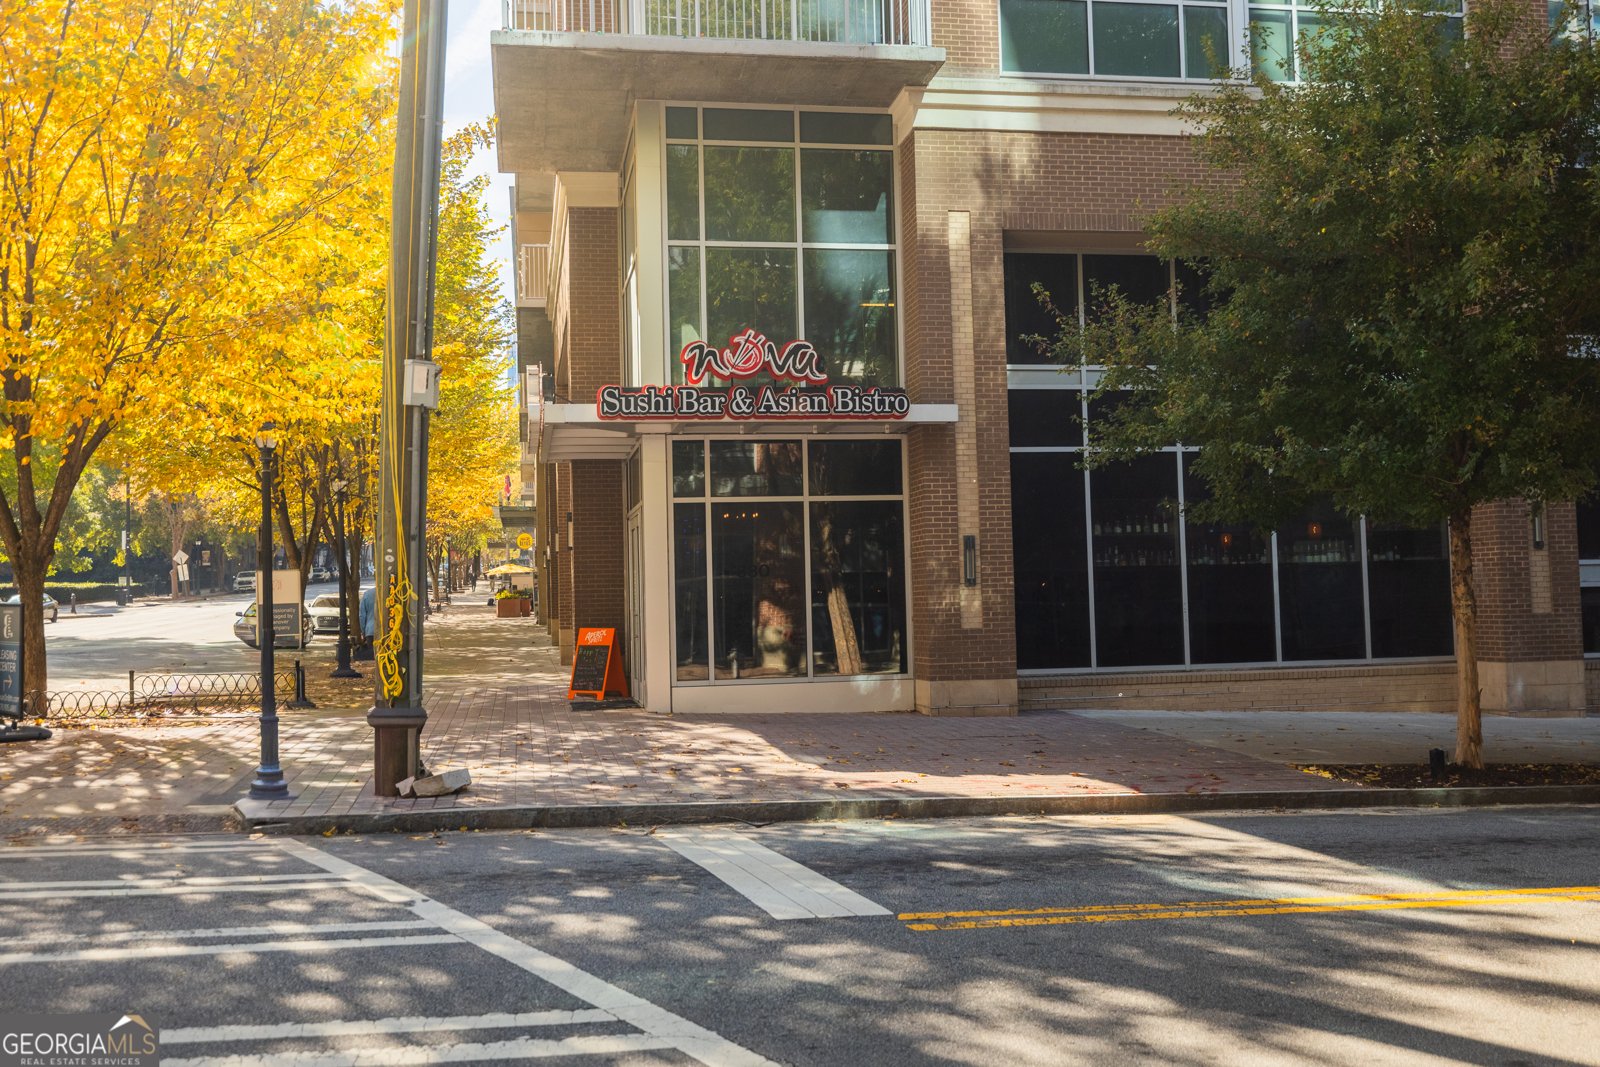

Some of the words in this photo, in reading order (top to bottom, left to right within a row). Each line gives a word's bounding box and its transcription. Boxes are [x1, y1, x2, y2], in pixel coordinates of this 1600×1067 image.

[601, 386, 676, 415] Sushi
[677, 386, 726, 415] Bar
[731, 386, 754, 415] &
[757, 386, 830, 415] Asian
[833, 385, 910, 416] Bistro
[0, 649, 17, 661] EASING
